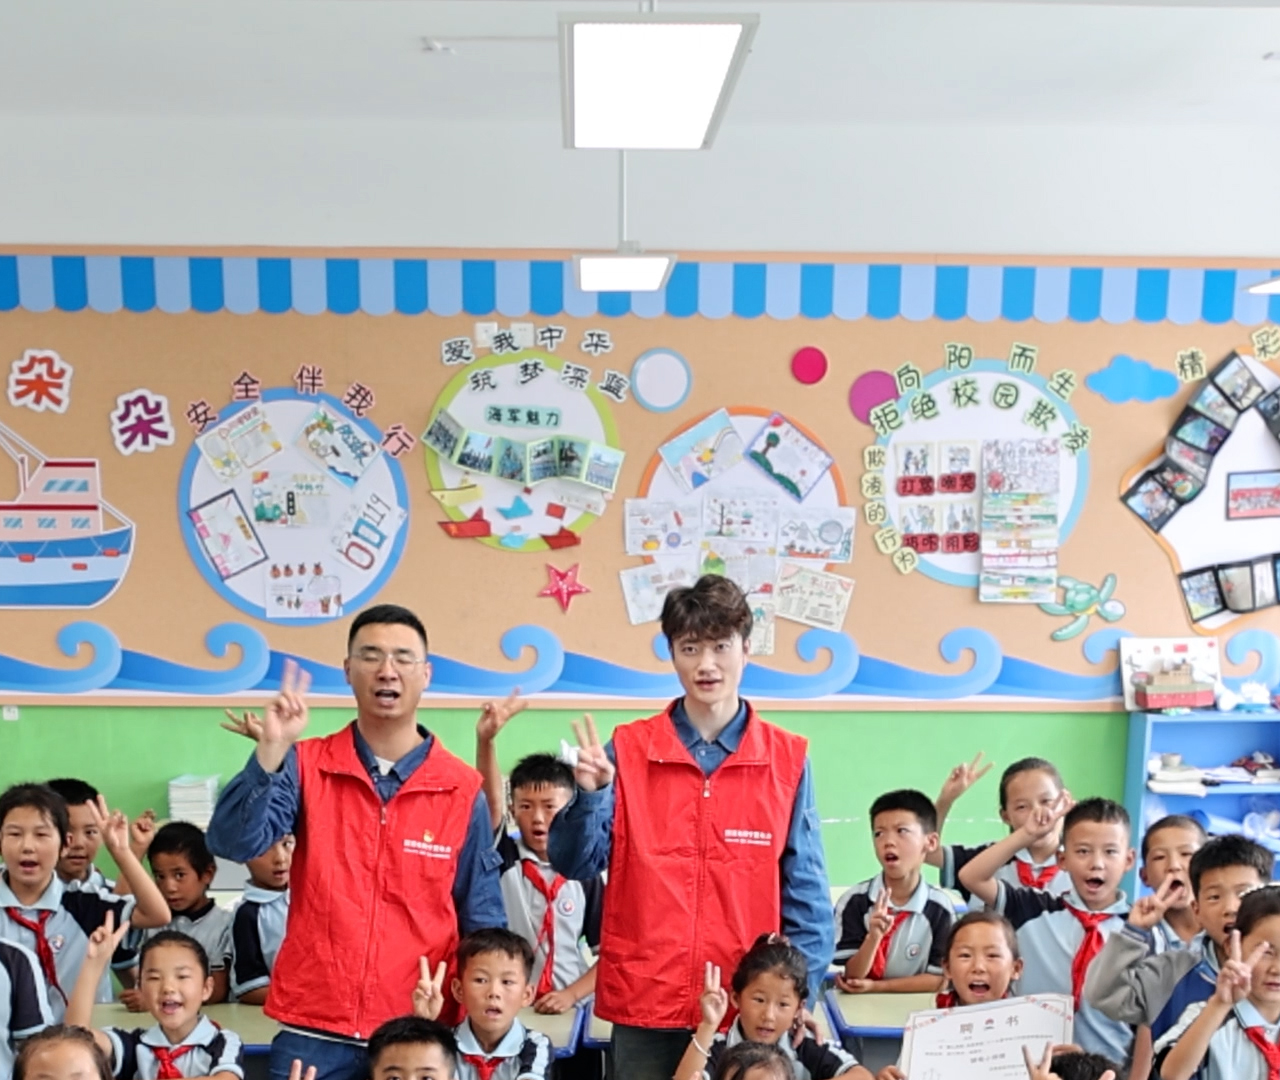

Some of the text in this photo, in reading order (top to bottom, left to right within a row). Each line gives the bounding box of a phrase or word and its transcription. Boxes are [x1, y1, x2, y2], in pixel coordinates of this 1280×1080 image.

[444, 327, 610, 363] 爱我中华
[896, 344, 1075, 399] 向阳而生
[471, 361, 628, 399] 筑梦深蓝
[187, 366, 413, 455] 安全伴我行
[488, 406, 559, 426] 海军魅力
[874, 379, 1089, 453] 拒绝校园欺凌
[865, 450, 916, 569] 欺凌的行为
